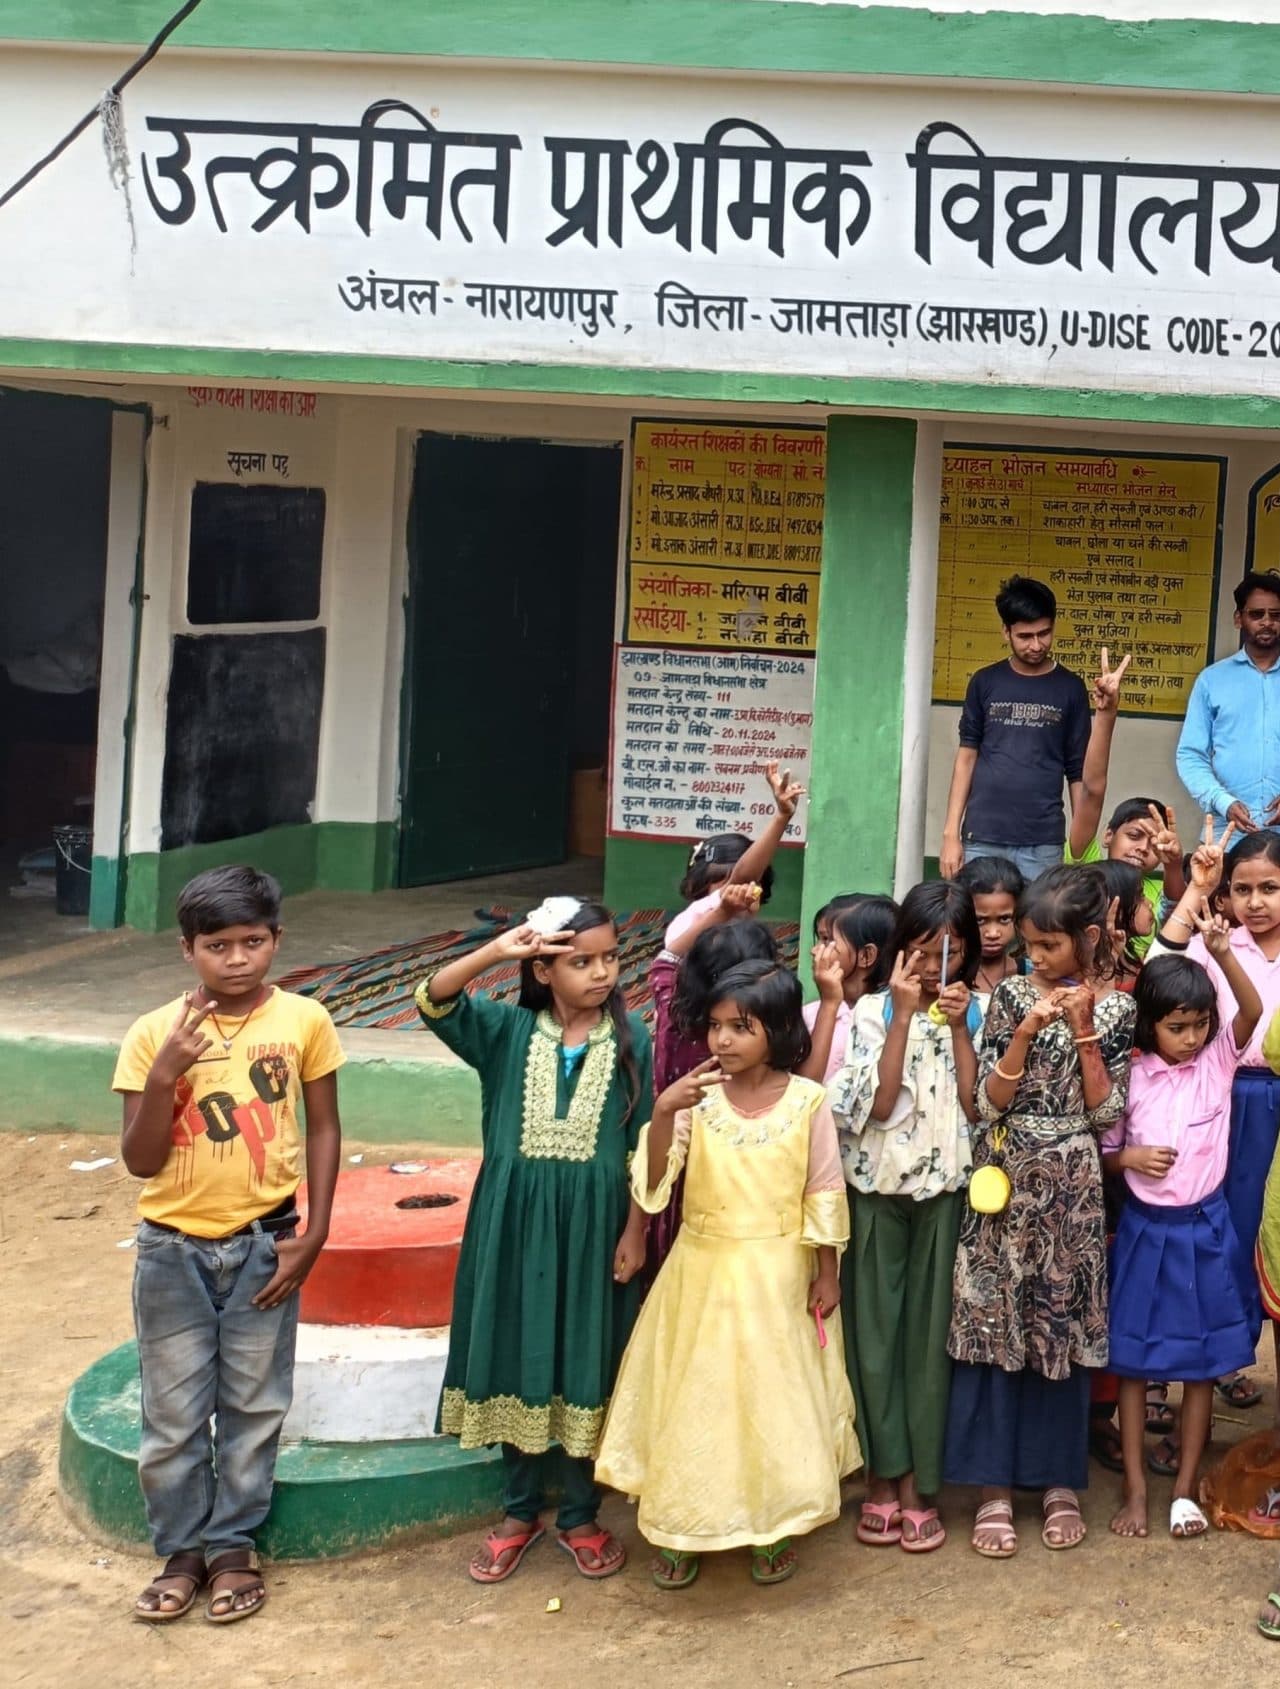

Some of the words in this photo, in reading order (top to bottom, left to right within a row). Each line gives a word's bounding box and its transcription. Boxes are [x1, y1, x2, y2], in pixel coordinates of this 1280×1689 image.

[141, 99, 523, 244] उत्क्रमित
[544, 117, 873, 258] प्राथमिक
[1061, 310, 1151, 350] U-DISE
[227, 451, 266, 476] सूचना
[668, 458, 694, 473] नाम
[717, 692, 731, 702] 111
[247, 1042, 297, 1061] URBAN
